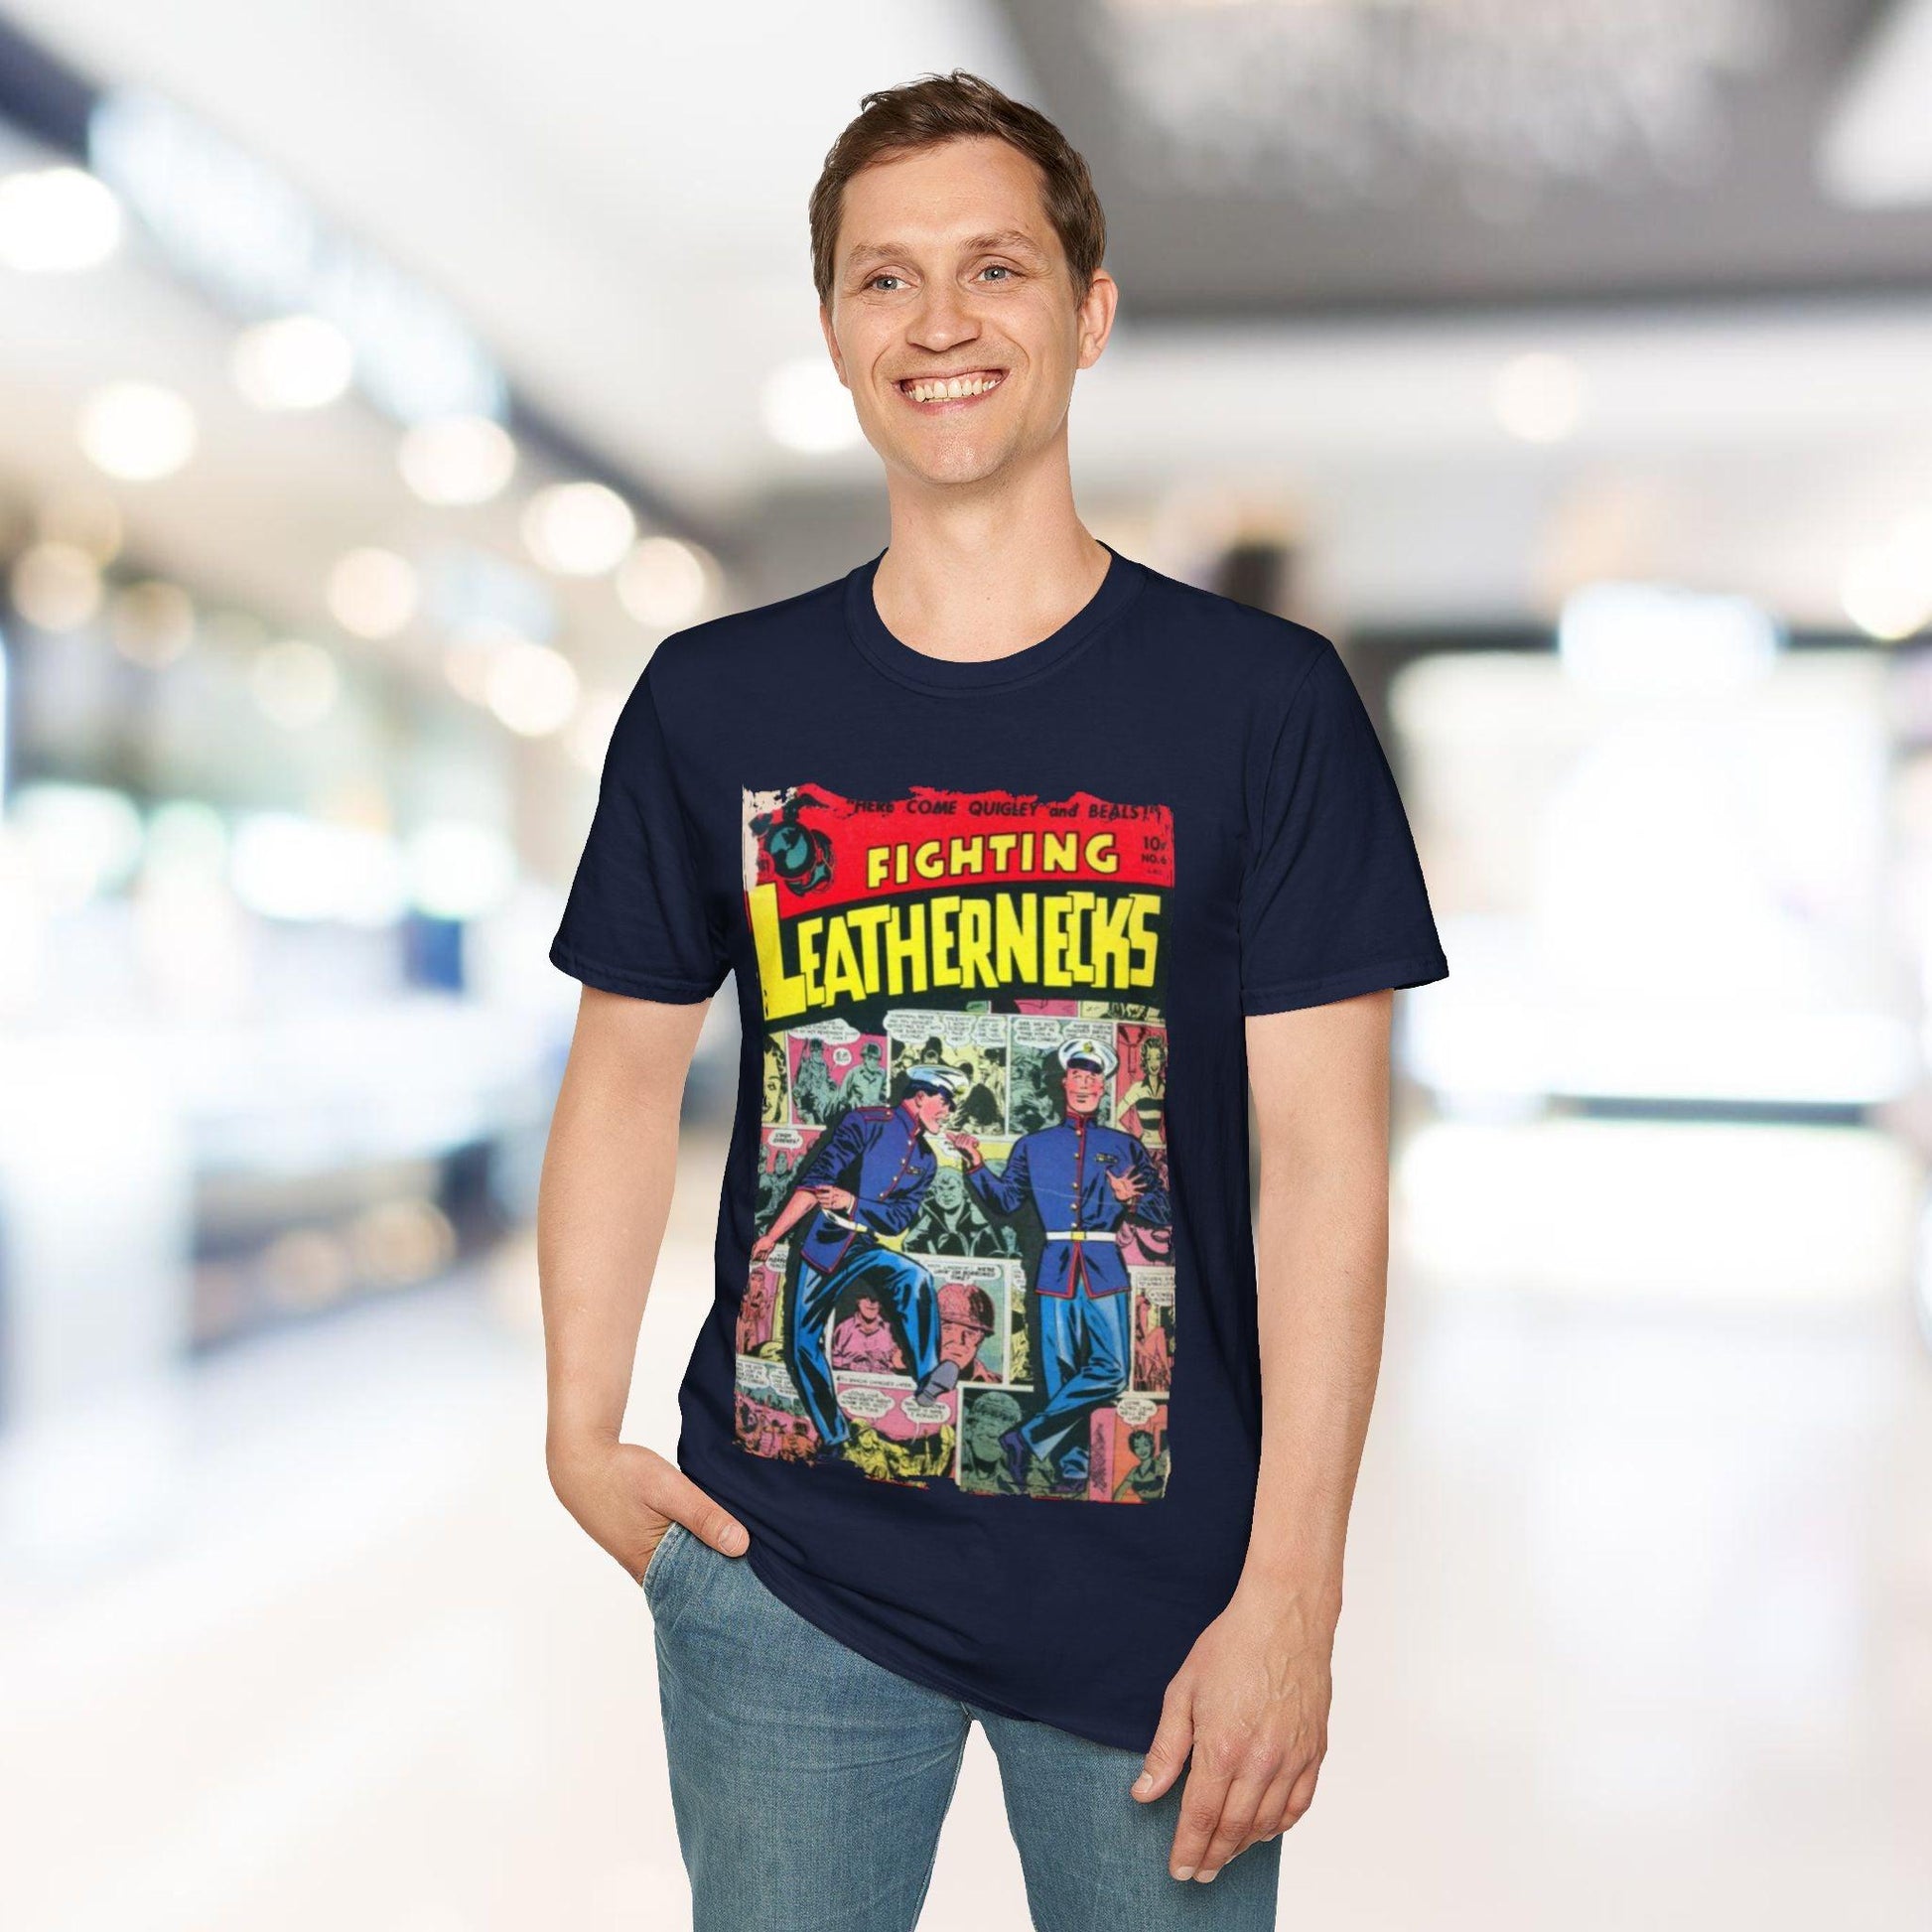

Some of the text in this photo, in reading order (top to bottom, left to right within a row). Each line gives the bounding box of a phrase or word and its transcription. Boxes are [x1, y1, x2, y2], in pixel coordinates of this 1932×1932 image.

[906, 799, 958, 815] COME
[968, 800, 1037, 817] QUIGLEY
[1048, 802, 1079, 818] and
[866, 831, 1120, 890] FIGHTING
[748, 882, 1163, 1022] LEATHERNECKS
